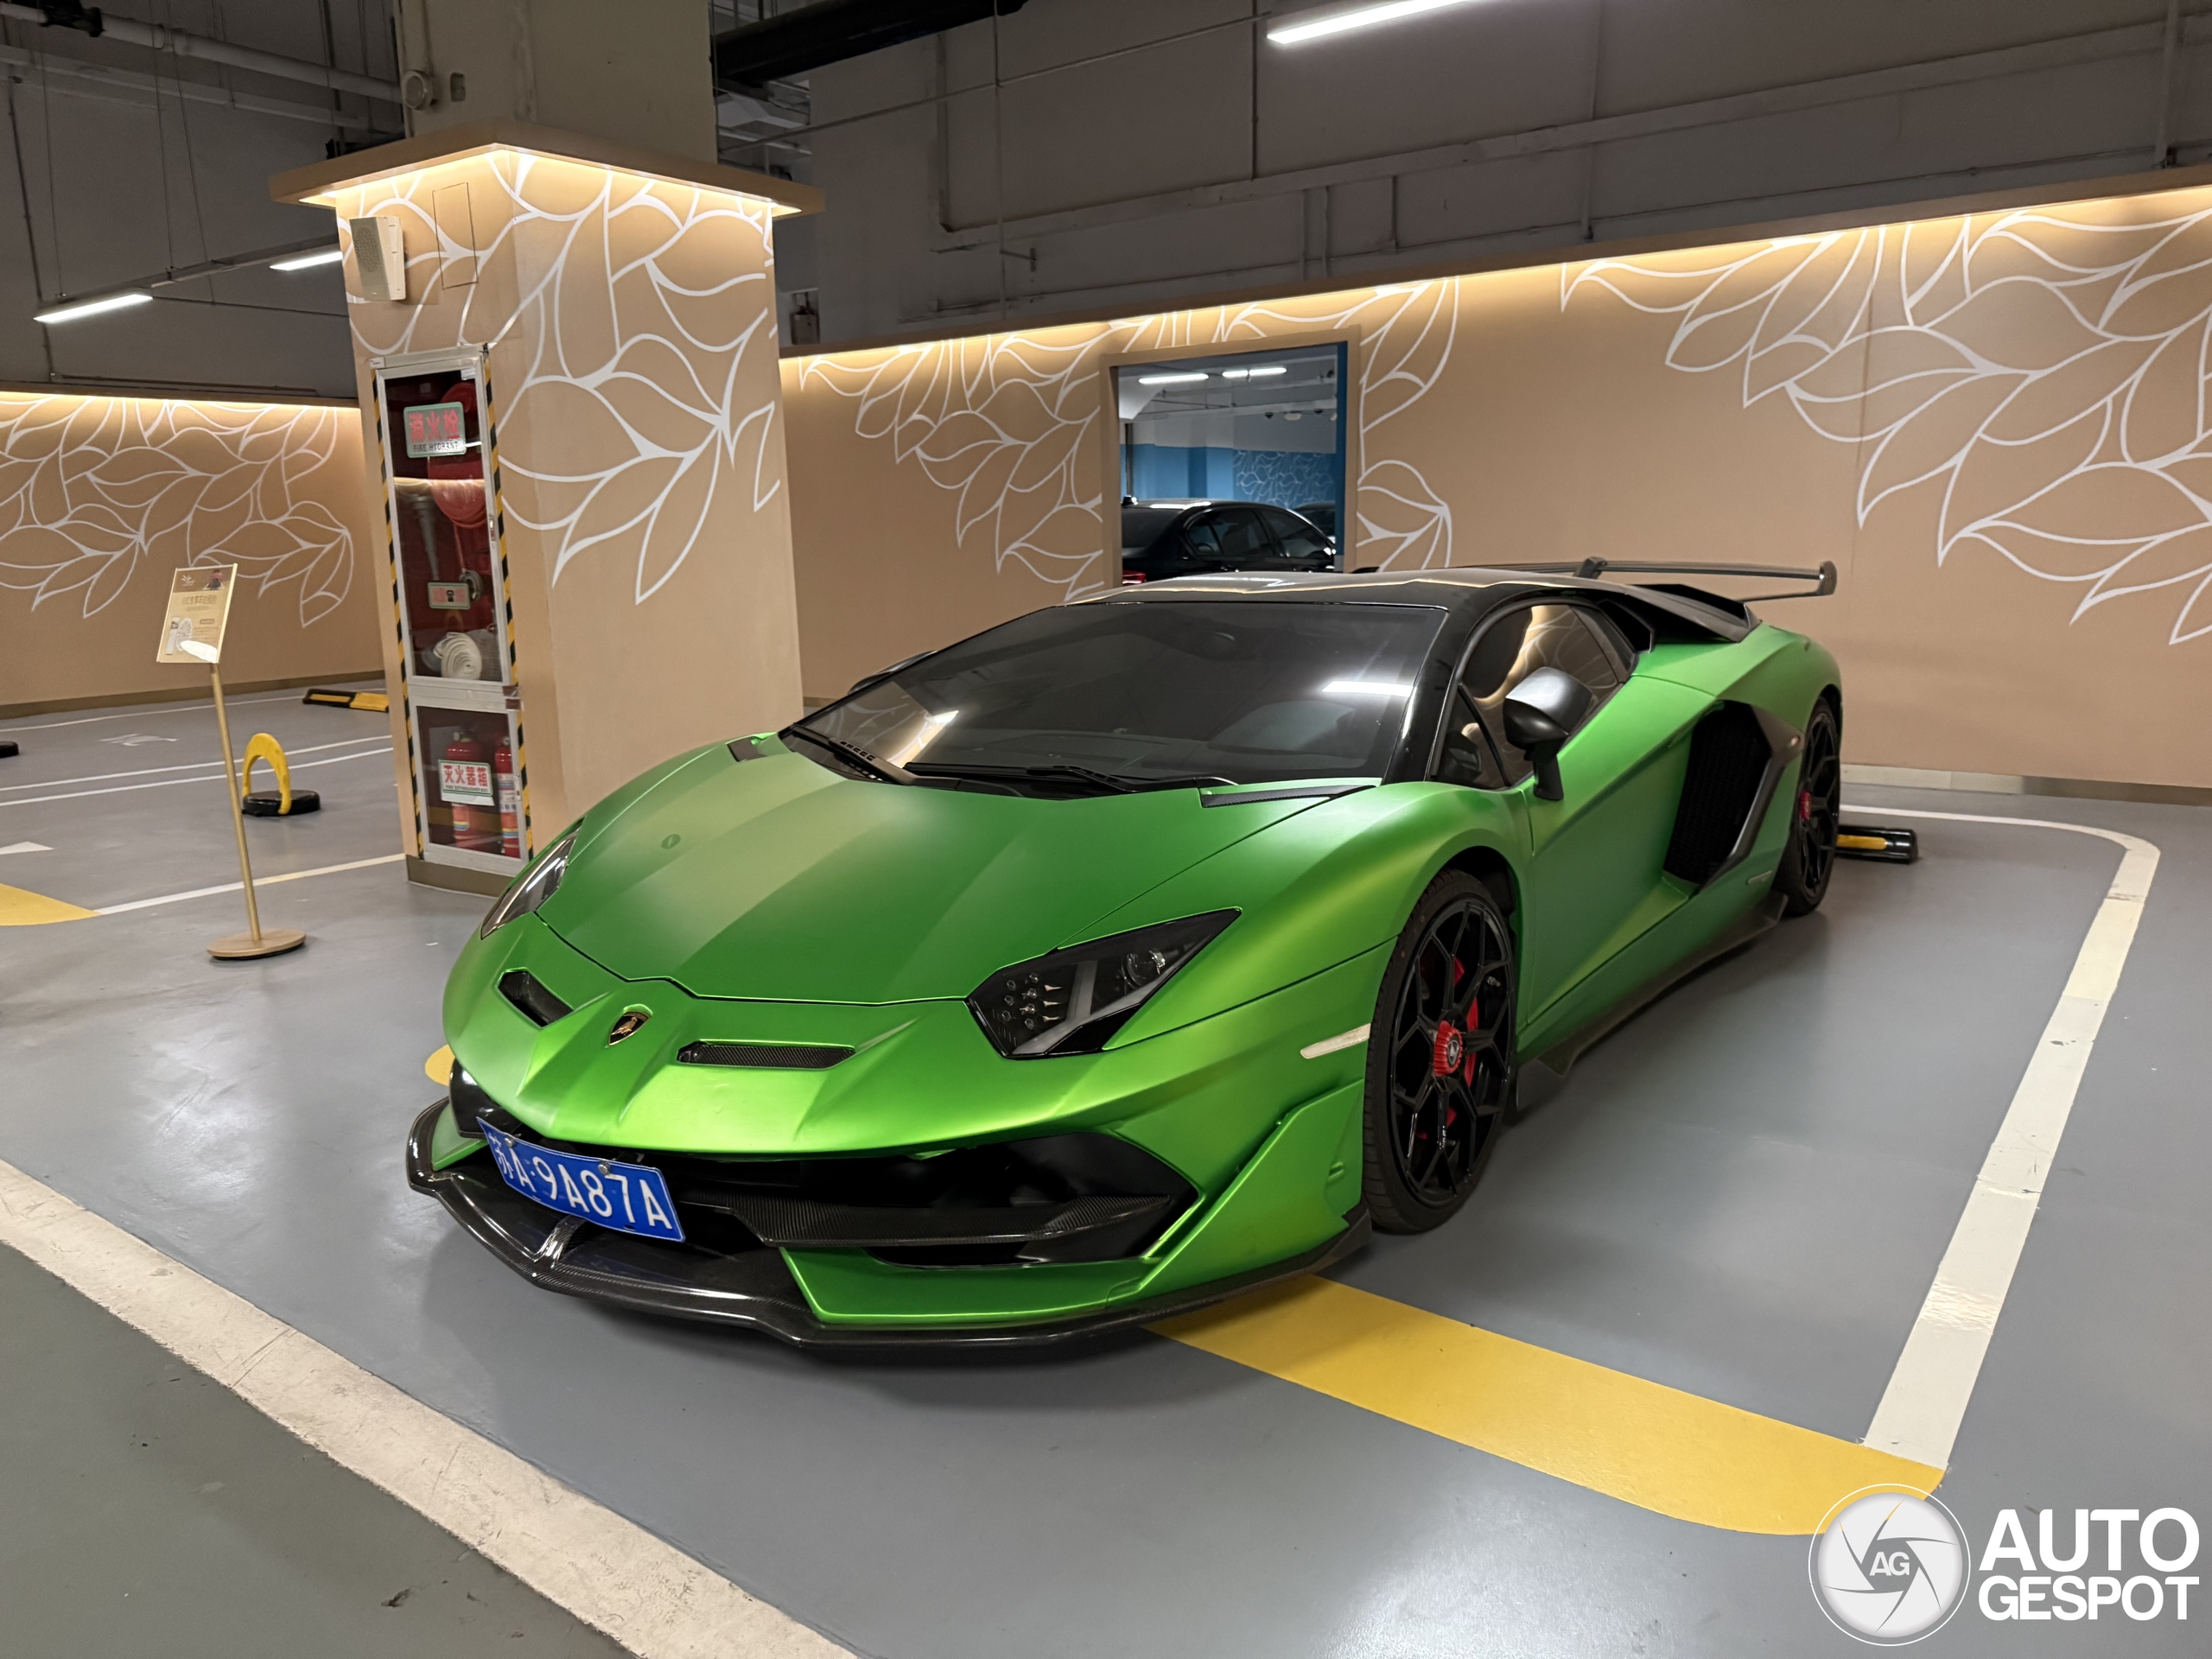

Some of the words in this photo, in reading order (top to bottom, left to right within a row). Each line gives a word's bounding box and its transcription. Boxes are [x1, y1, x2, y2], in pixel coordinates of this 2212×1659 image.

[409, 408, 461, 443] 消火栓
[443, 765, 488, 787] 灭火器箱
